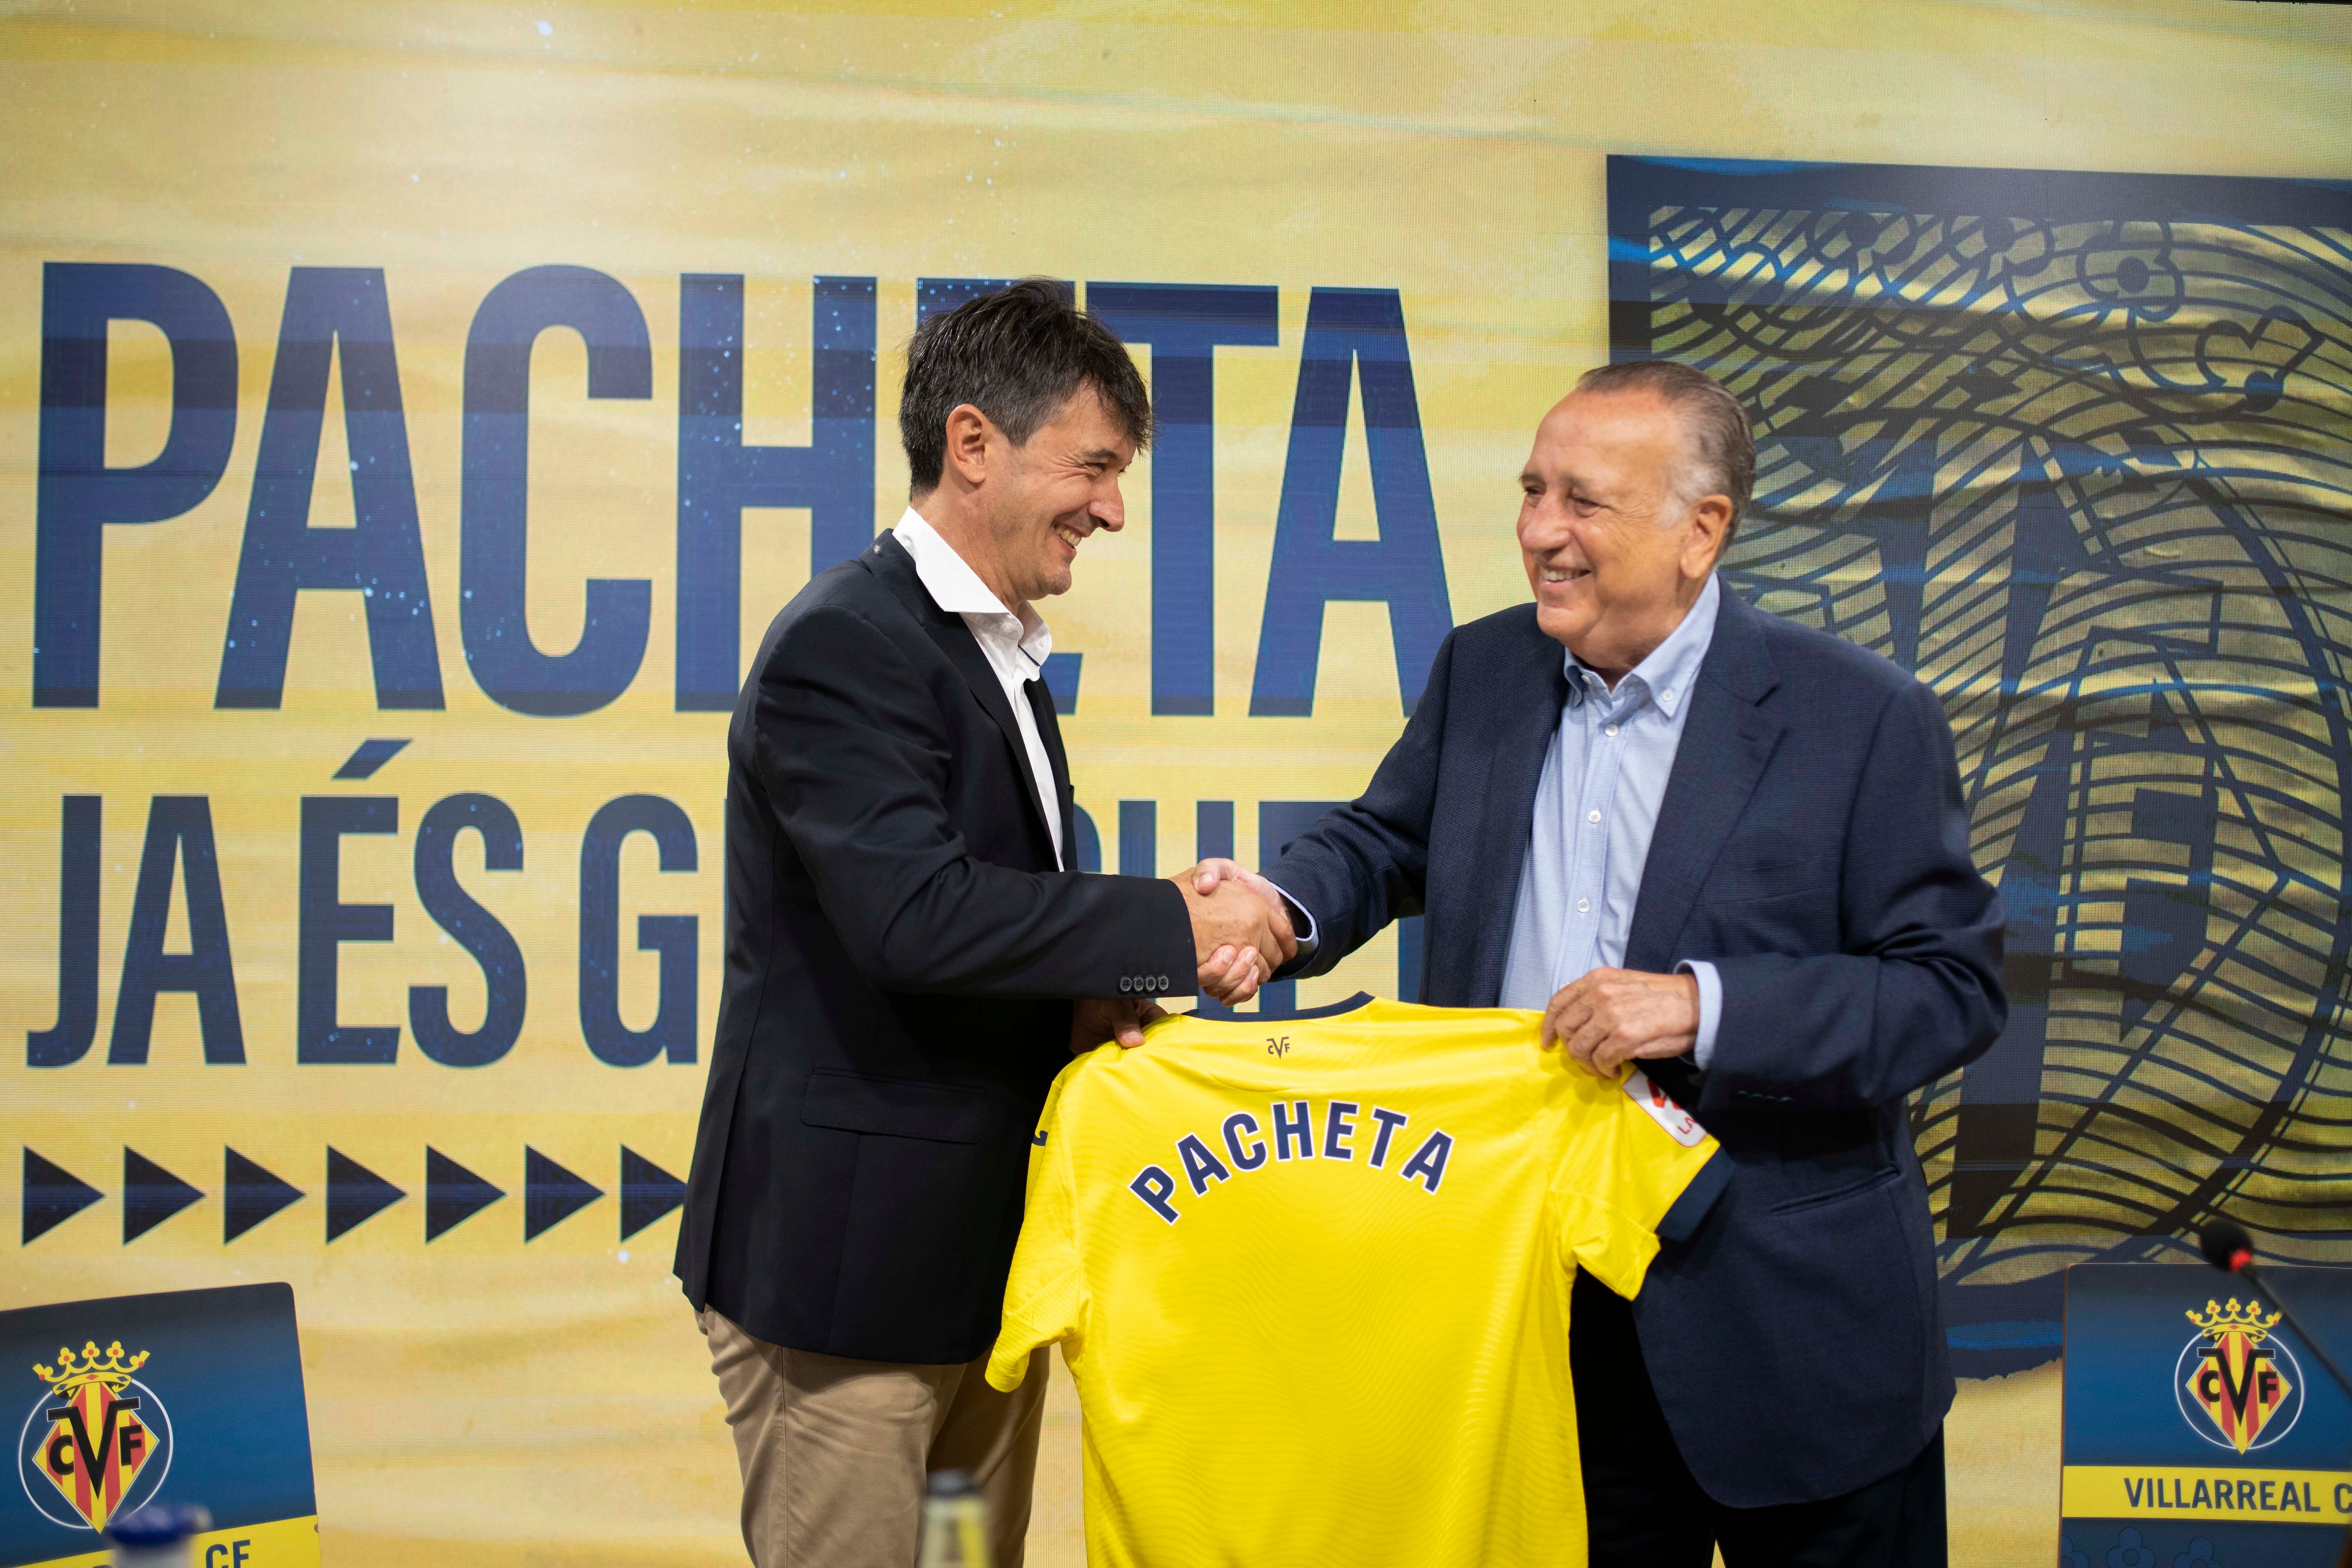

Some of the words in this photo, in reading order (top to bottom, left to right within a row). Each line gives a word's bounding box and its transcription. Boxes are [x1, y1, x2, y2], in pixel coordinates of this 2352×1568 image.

[32, 262, 1453, 717] PACHTA
[26, 794, 247, 1068] JA
[296, 739, 527, 1069] ÉS
[1128, 1099, 1455, 1226] PACHETA
[2123, 1478, 2321, 1512] VILLARREAL
